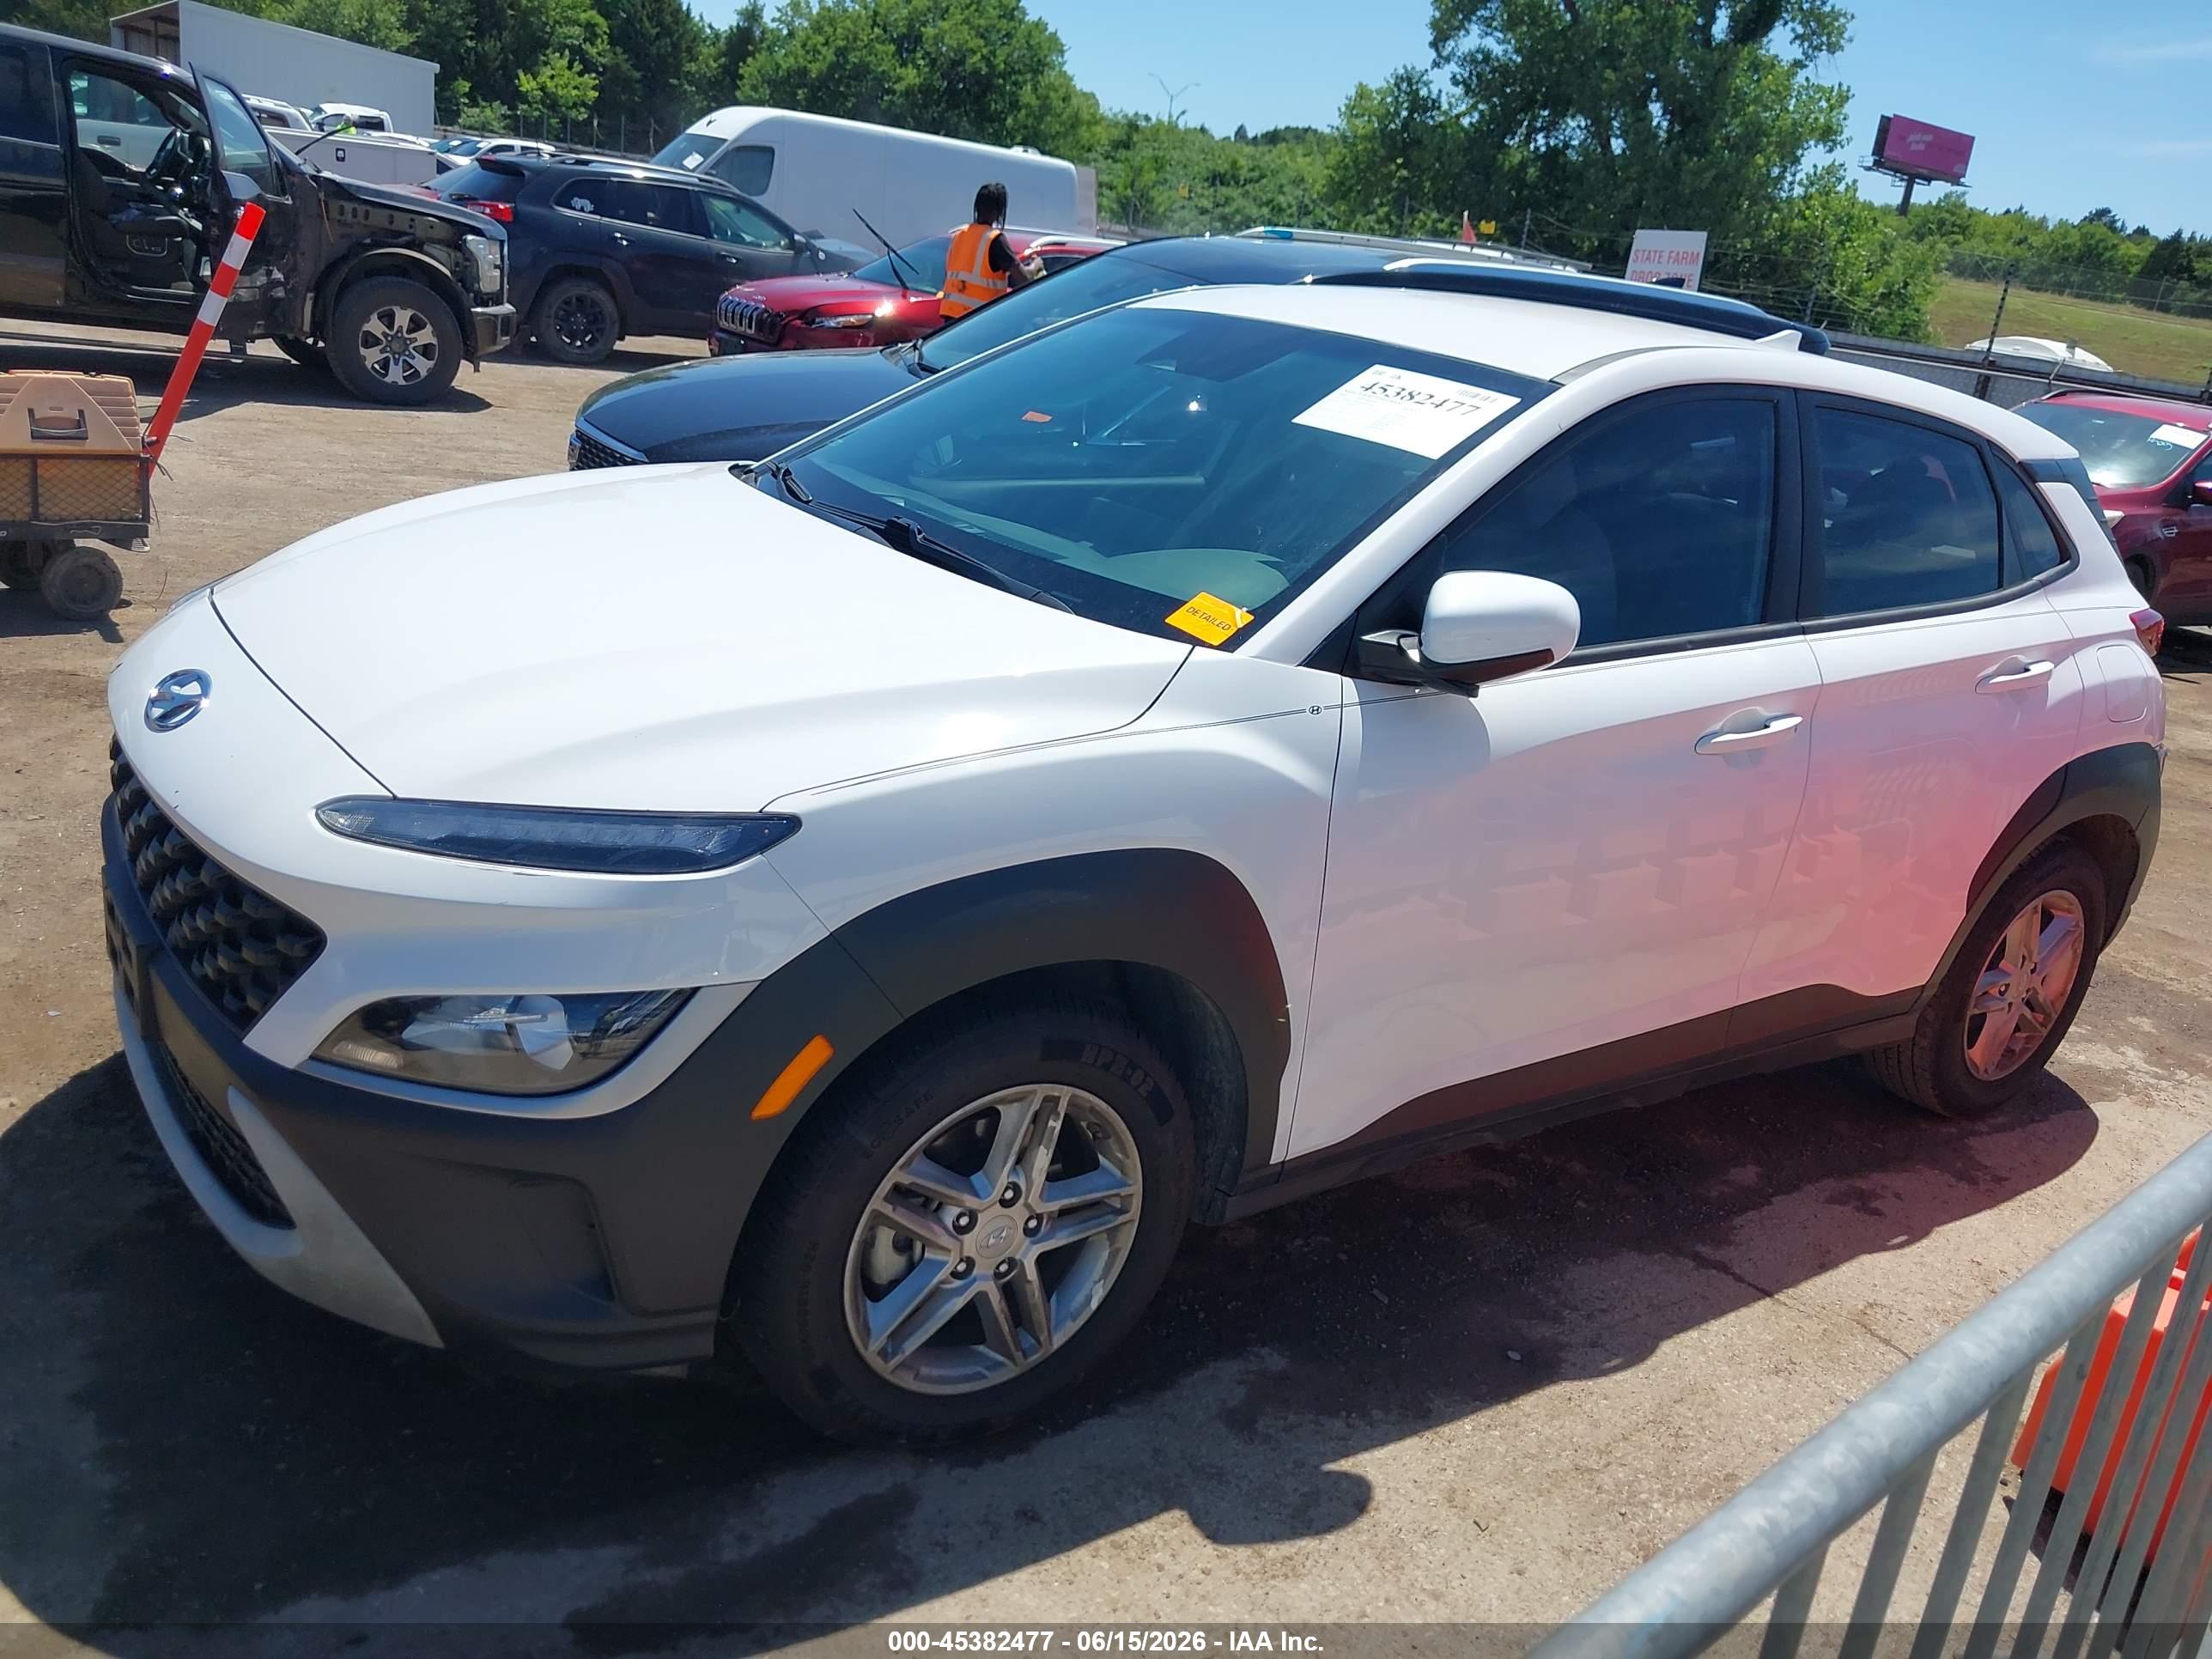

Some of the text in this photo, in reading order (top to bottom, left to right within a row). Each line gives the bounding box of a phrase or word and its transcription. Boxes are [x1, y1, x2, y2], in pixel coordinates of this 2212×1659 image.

[1633, 248, 1699, 266] STATE FARM
[1360, 381, 1481, 416] 45382477
[1186, 606, 1231, 631] DETAILED
